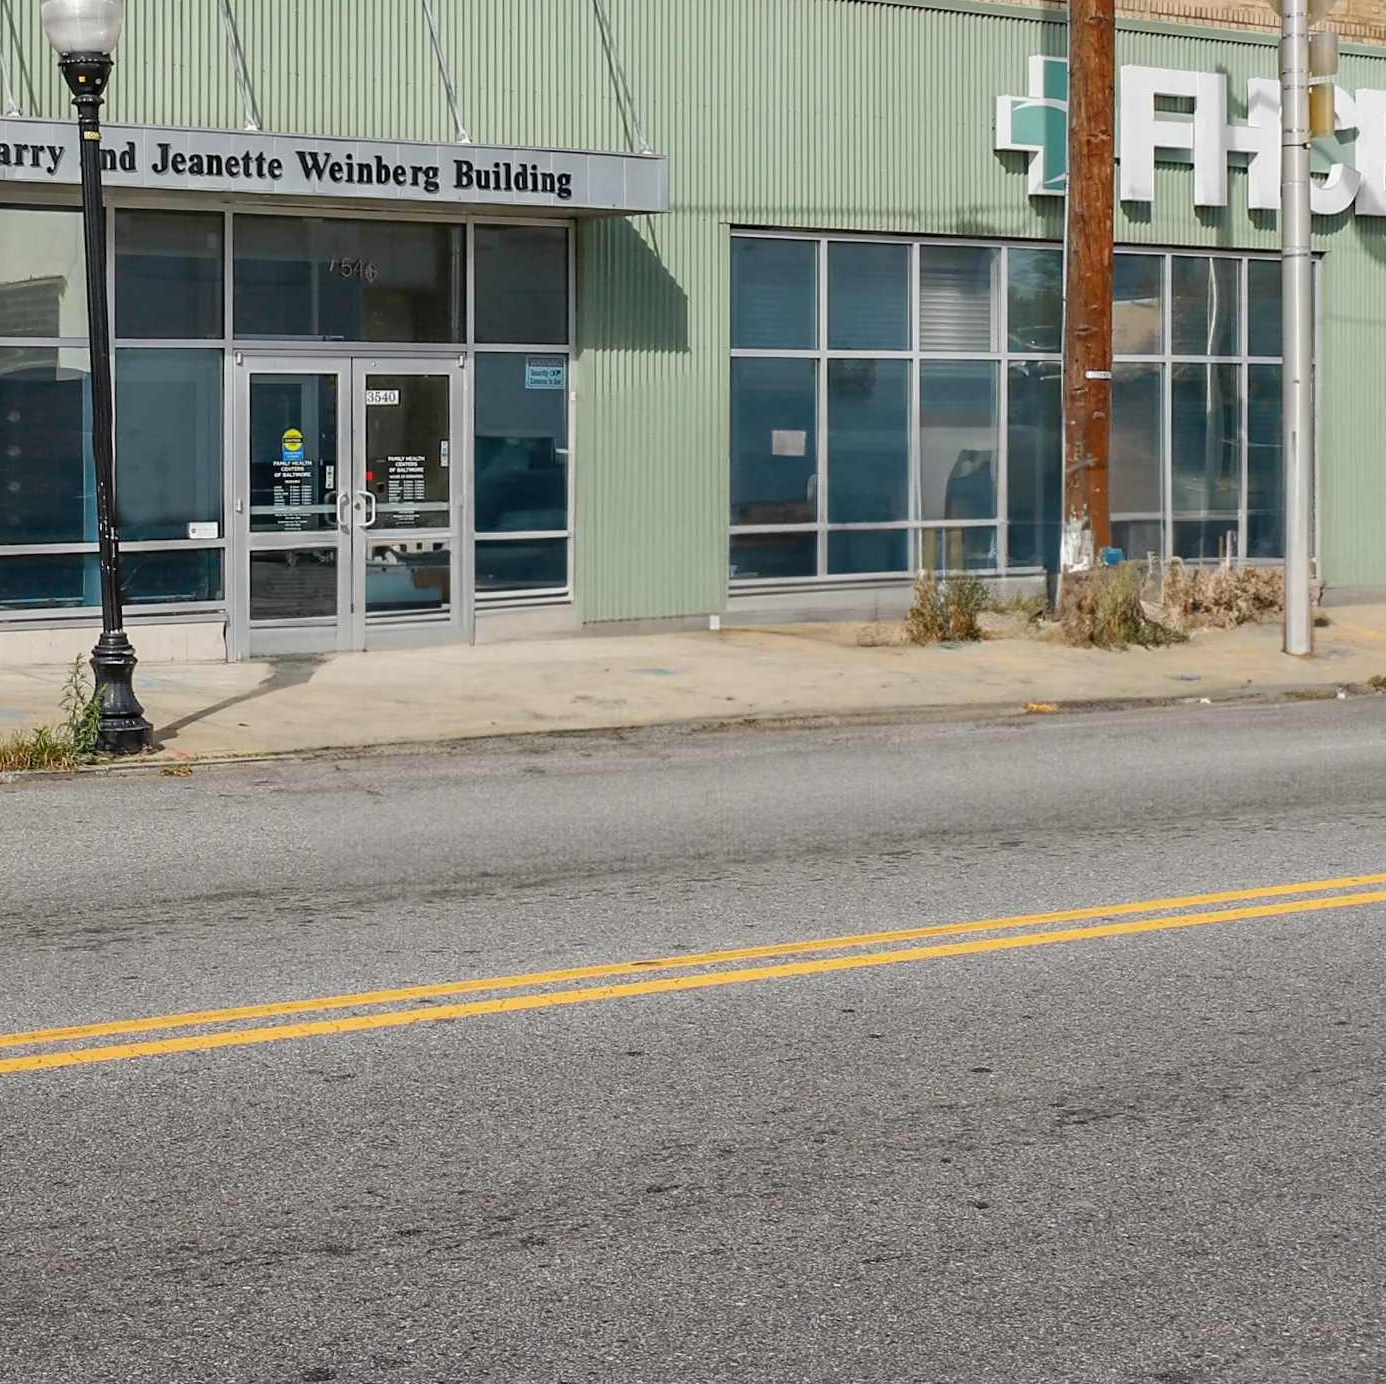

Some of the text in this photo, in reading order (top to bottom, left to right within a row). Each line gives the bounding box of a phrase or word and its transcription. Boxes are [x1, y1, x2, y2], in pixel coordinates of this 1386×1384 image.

[99, 141, 137, 172] nd
[151, 143, 284, 180] Jeanette
[296, 151, 440, 193] Weinberg
[453, 159, 573, 199] Building
[367, 391, 396, 403] 3540
